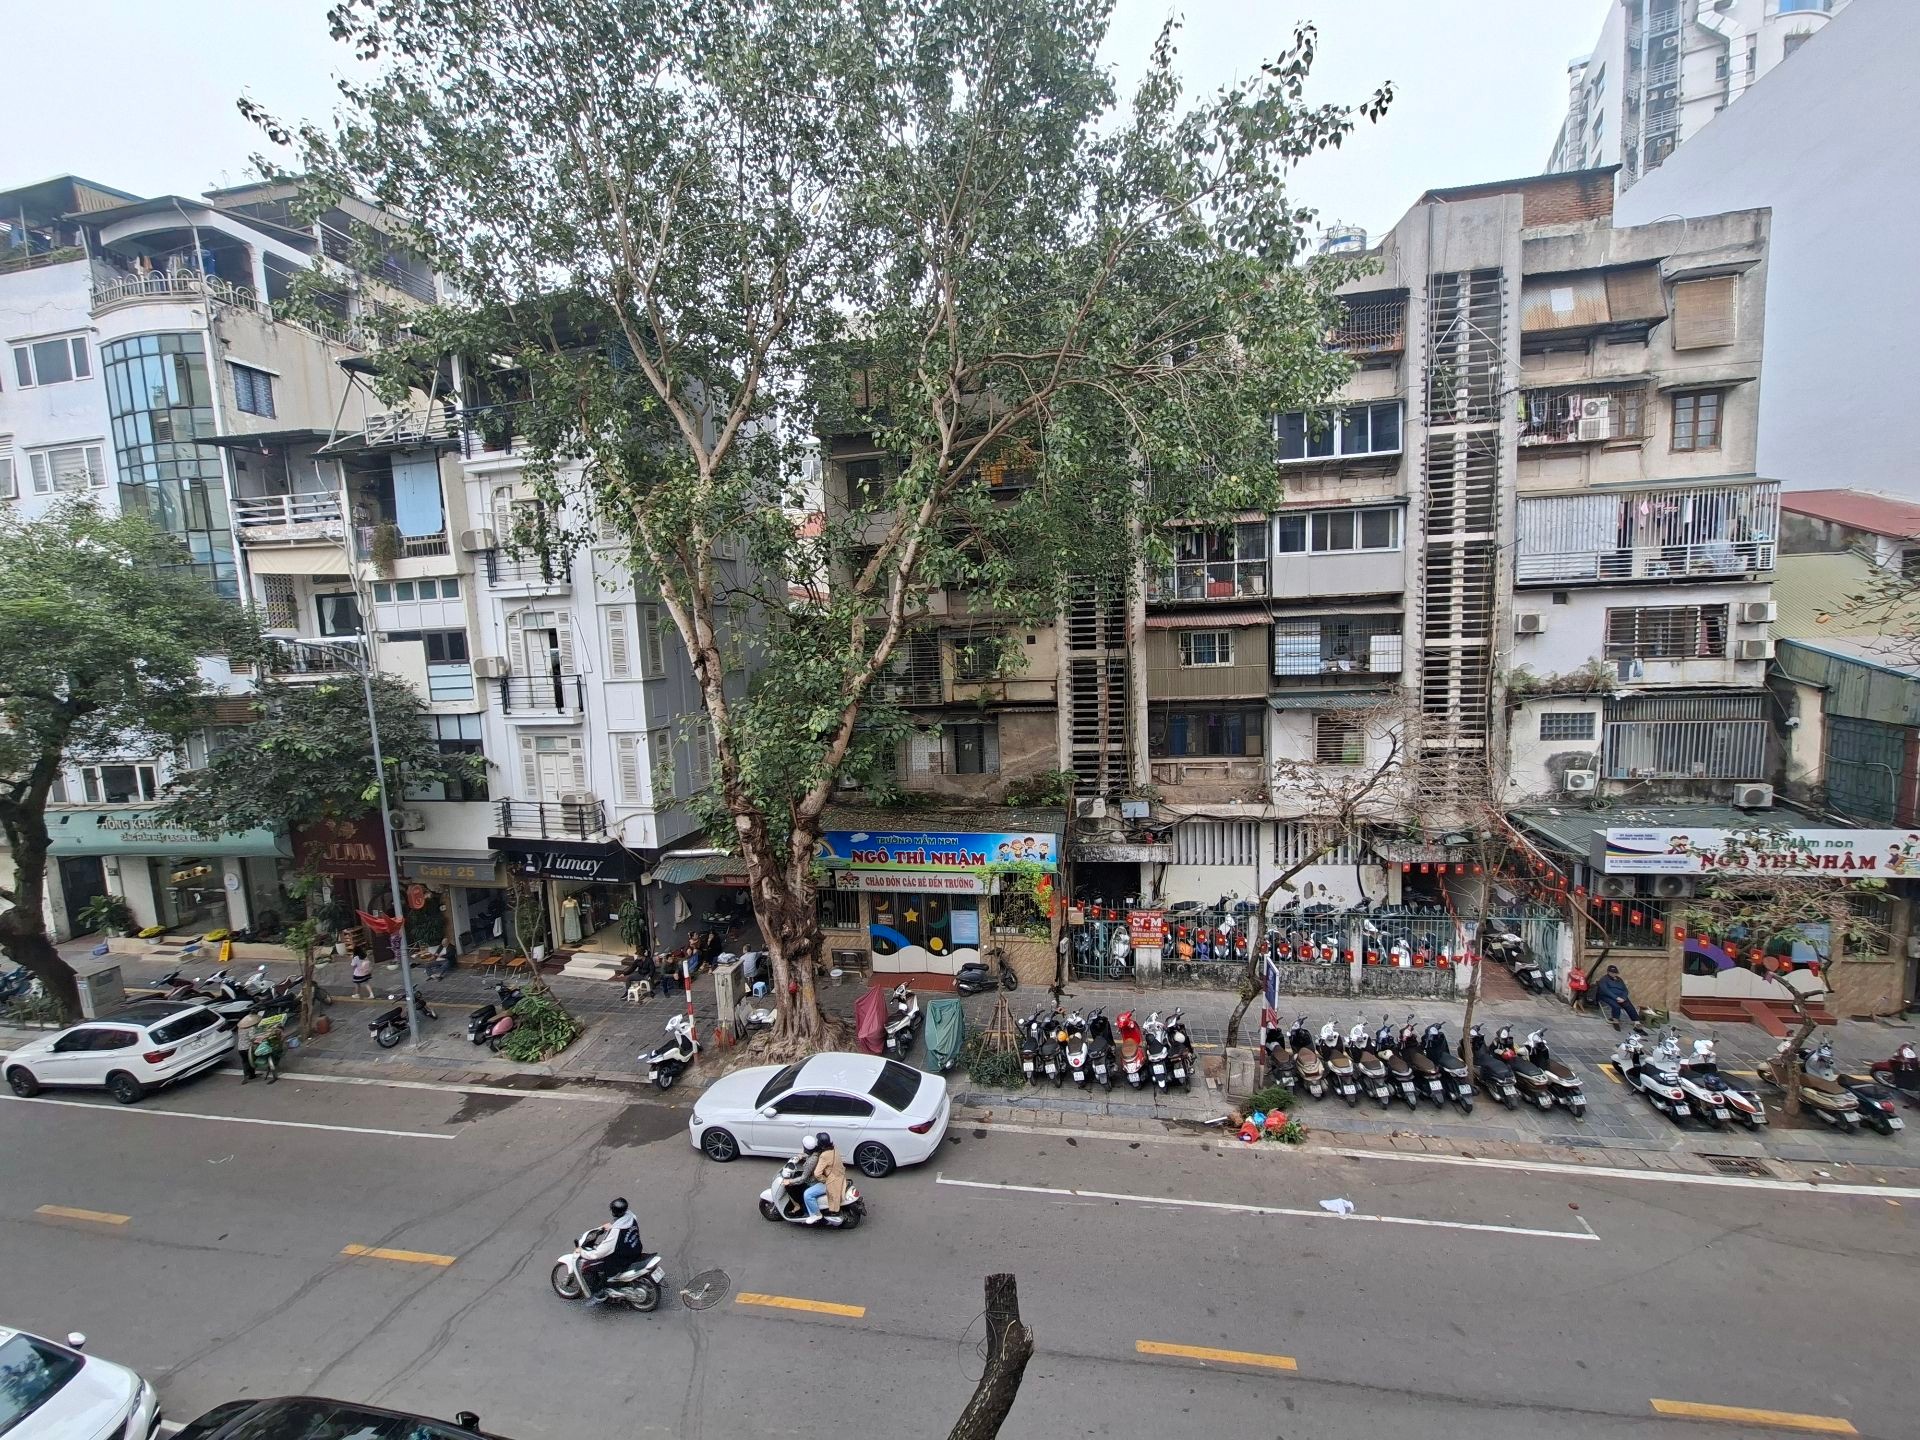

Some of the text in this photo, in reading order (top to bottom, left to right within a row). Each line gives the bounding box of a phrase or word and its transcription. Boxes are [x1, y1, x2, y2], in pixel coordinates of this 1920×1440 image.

[938, 837, 959, 845] NON
[1824, 839, 1854, 848] non
[543, 852, 604, 876] Túmay
[851, 846, 986, 869] NGÔ THÌ NHẬM
[1805, 851, 1877, 873] NHẬM
[456, 866, 476, 877] 25
[865, 874, 974, 889] CHÀO ĐÓN CÁC BÉ ĐẾN TRƯỜNG
